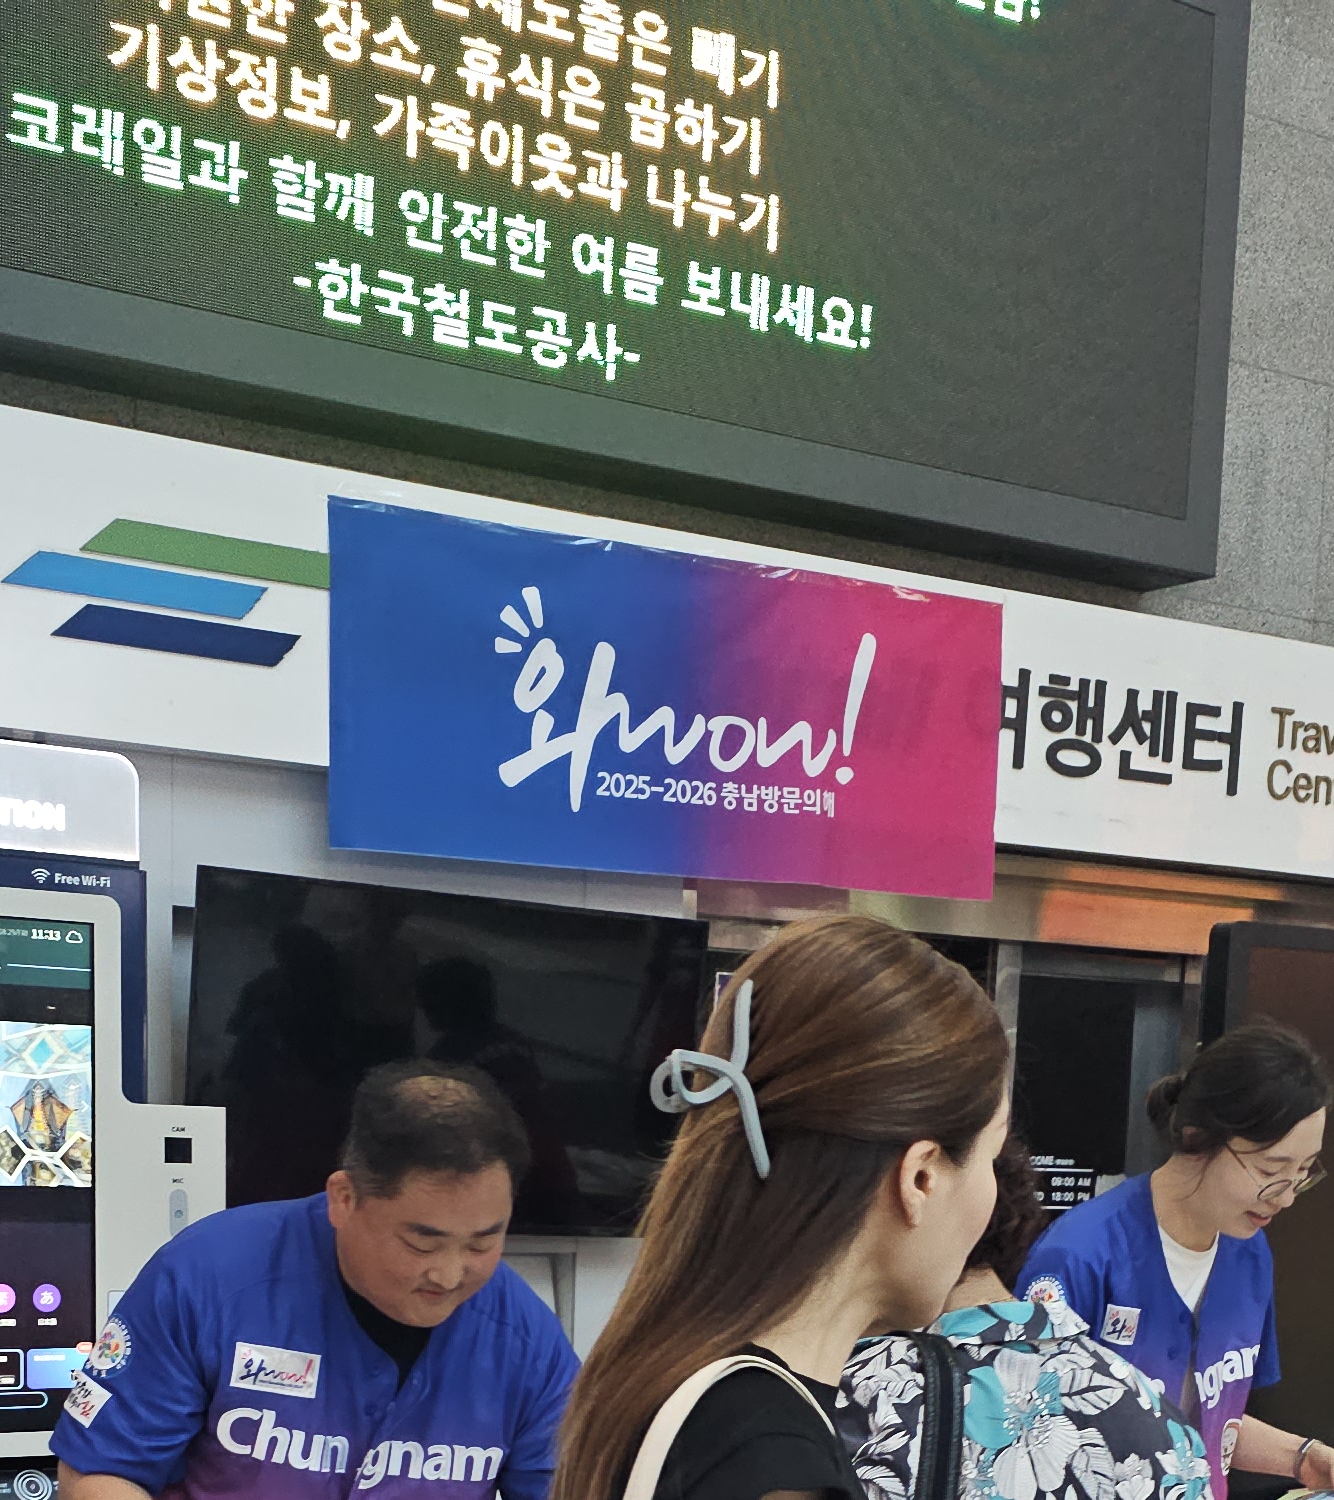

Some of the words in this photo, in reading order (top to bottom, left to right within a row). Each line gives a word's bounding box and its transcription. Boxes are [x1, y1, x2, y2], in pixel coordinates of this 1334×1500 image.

[315, 0, 436, 84] 장소,
[458, 36, 605, 131] 휴식은
[626, 82, 762, 177] 곱하기
[691, 26, 779, 109] 빼기
[108, 21, 350, 140] 기상정보,
[373, 94, 628, 212] 가족이웃과
[647, 165, 779, 253] 나누기
[6, 92, 248, 204] 코레일과
[269, 155, 374, 236] 함께
[399, 189, 551, 279] 안전한
[572, 233, 665, 305] 여름
[681, 261, 873, 350] 보내세요!
[293, 258, 641, 381] -한국철도공사-
[595, 771, 717, 807] 2025-2026
[54, 872, 80, 886] Free
[82, 874, 111, 888] Wi-Fi
[31, 928, 62, 942] 11:13
[39, 1291, 55, 1306] あ
